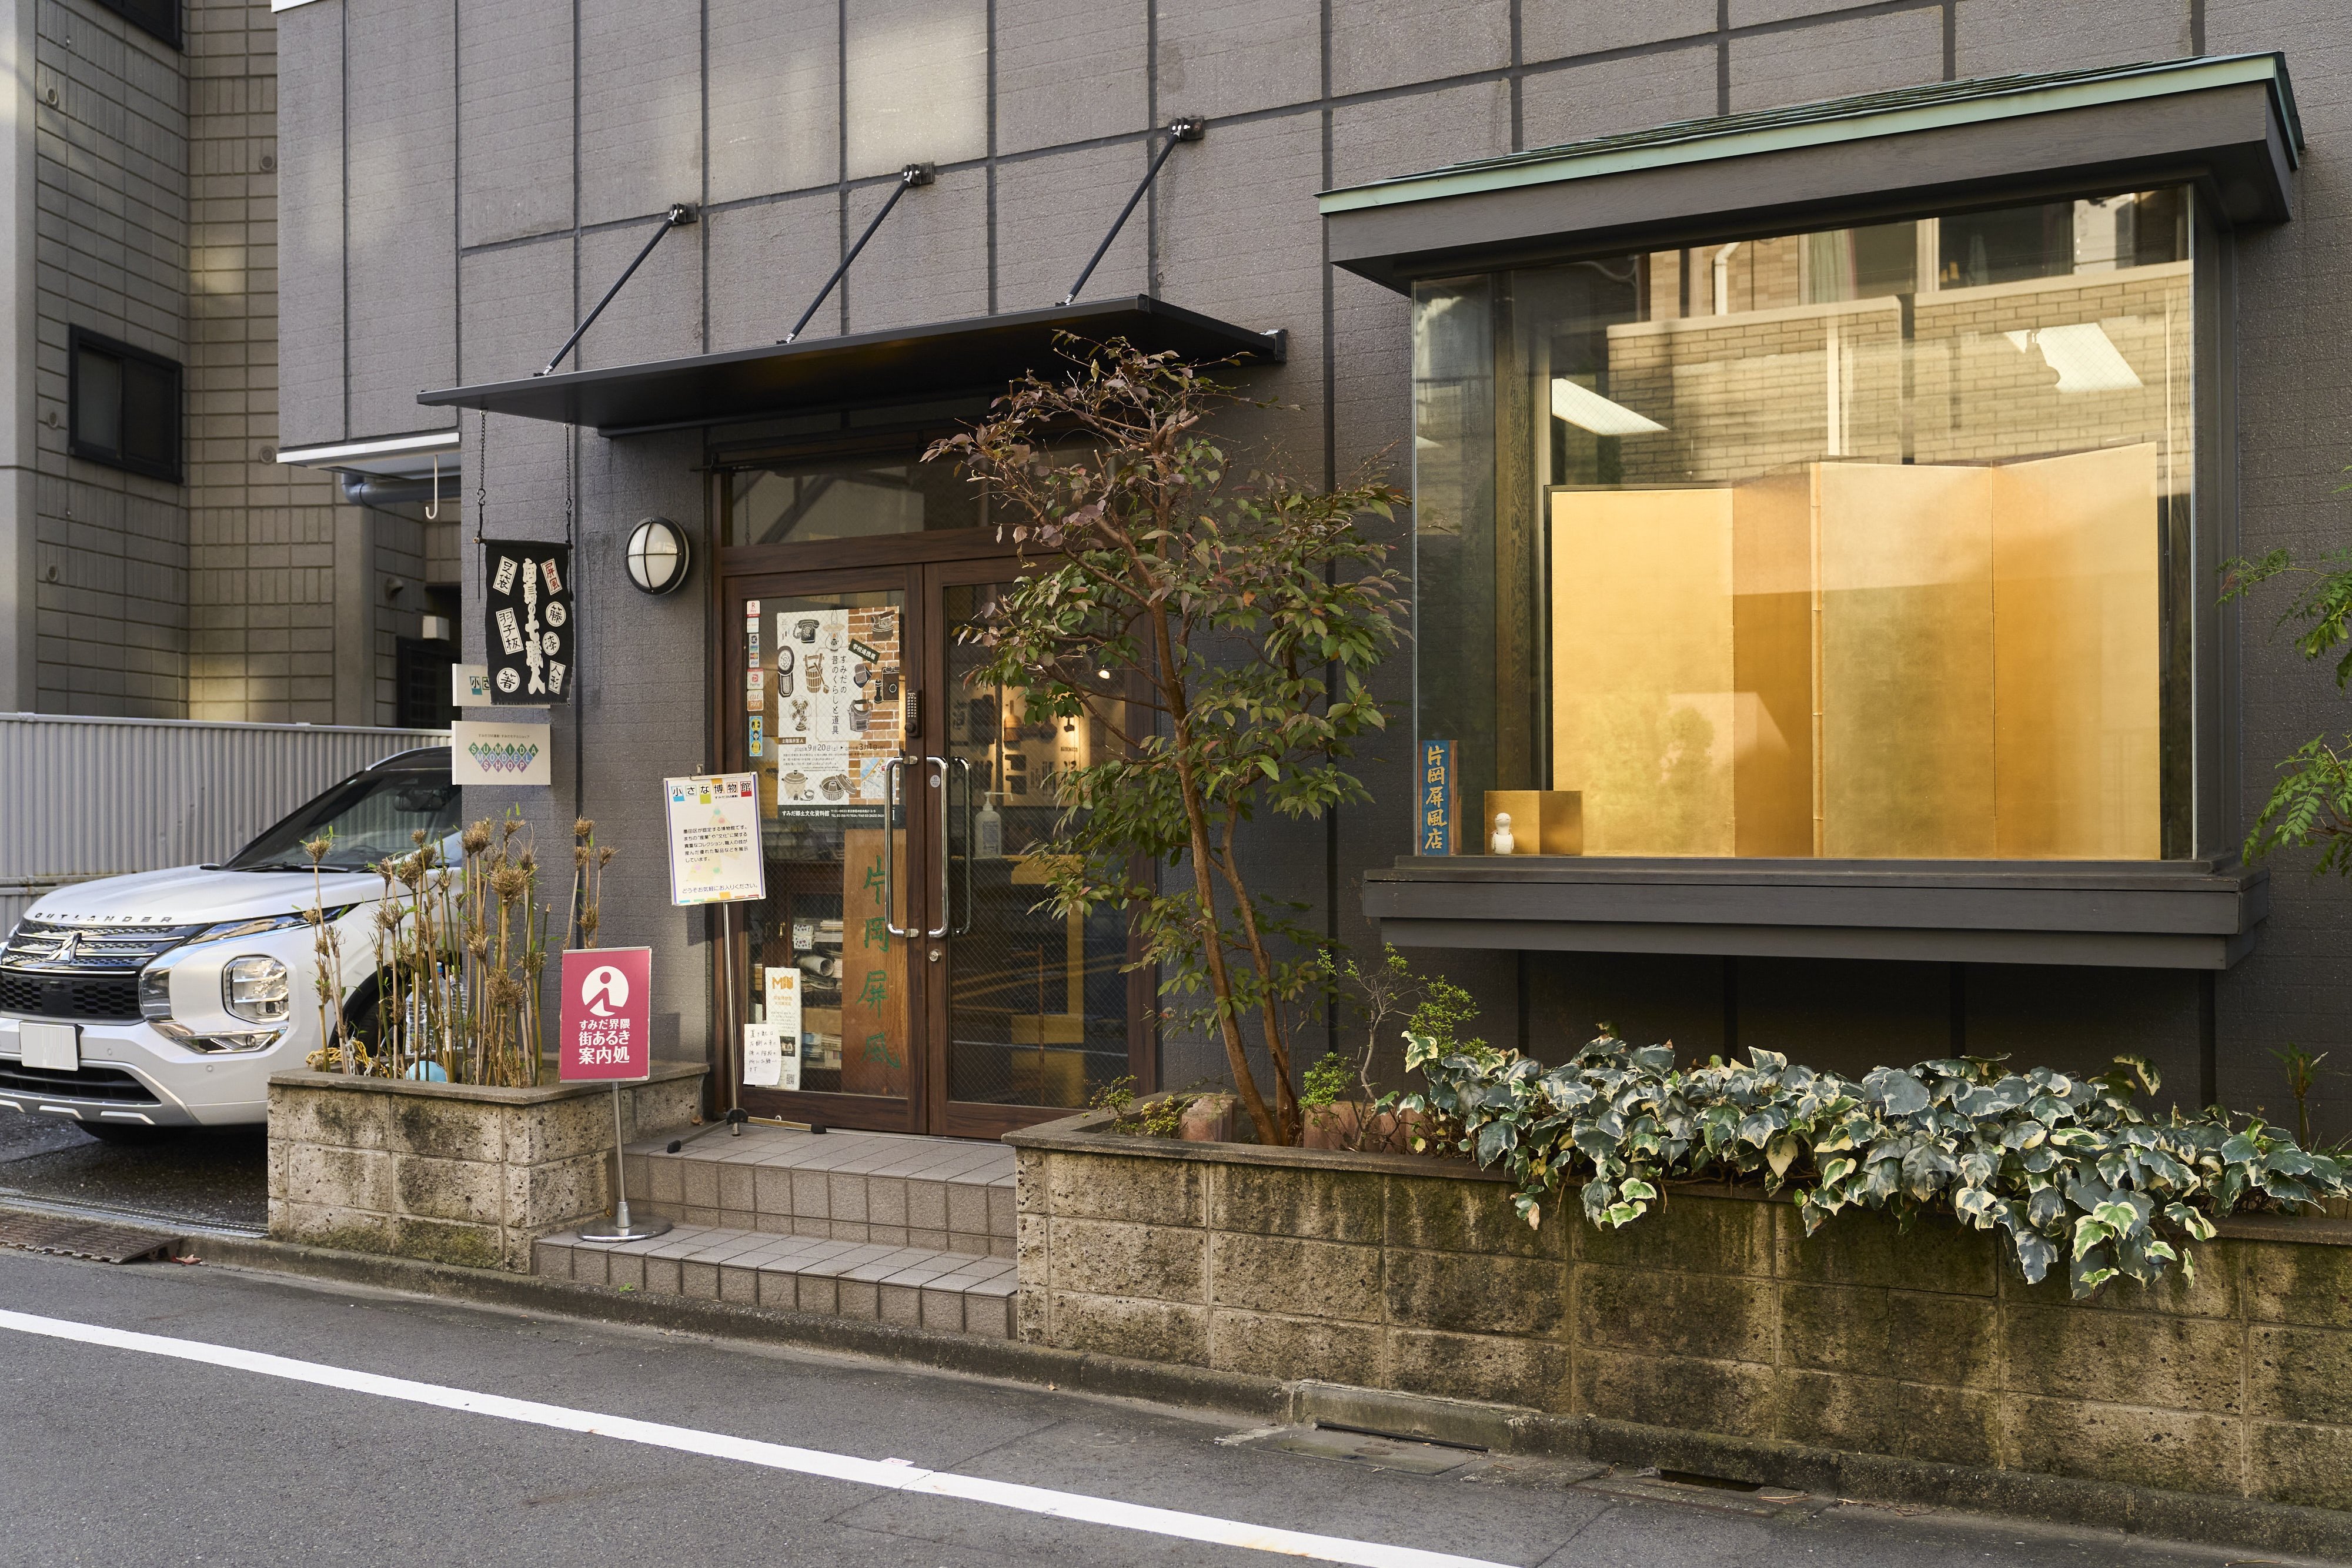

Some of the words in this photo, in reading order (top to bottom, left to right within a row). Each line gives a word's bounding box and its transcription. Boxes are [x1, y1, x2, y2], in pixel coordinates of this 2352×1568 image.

[497, 561, 513, 590] 足袋
[544, 561, 560, 591] 屏風
[499, 611, 521, 651] 羽子板
[522, 558, 546, 694] 向島の七職人
[544, 635, 557, 651] 漆
[550, 665, 561, 690] 人形
[831, 656, 840, 735] 昔のくらしと道具
[471, 745, 536, 755] SUMIDA
[476, 753, 530, 763] MODEL
[483, 761, 525, 770] SHOP
[673, 781, 751, 797] 小さな博物館
[1424, 744, 1448, 850] 片岡屏風店
[683, 825, 747, 834] 墨田区が認定する博物館です。
[684, 839, 748, 848] 貴重なコレクション、職人の技が
[682, 883, 759, 894] どうぞお気軽にお入りください。
[34, 912, 173, 923] OUTLANDER
[856, 854, 901, 1069] 片岡屏風
[579, 1018, 630, 1031] すみだ界隈
[579, 1030, 630, 1047] 街あるき
[578, 1047, 630, 1065] 案内処
